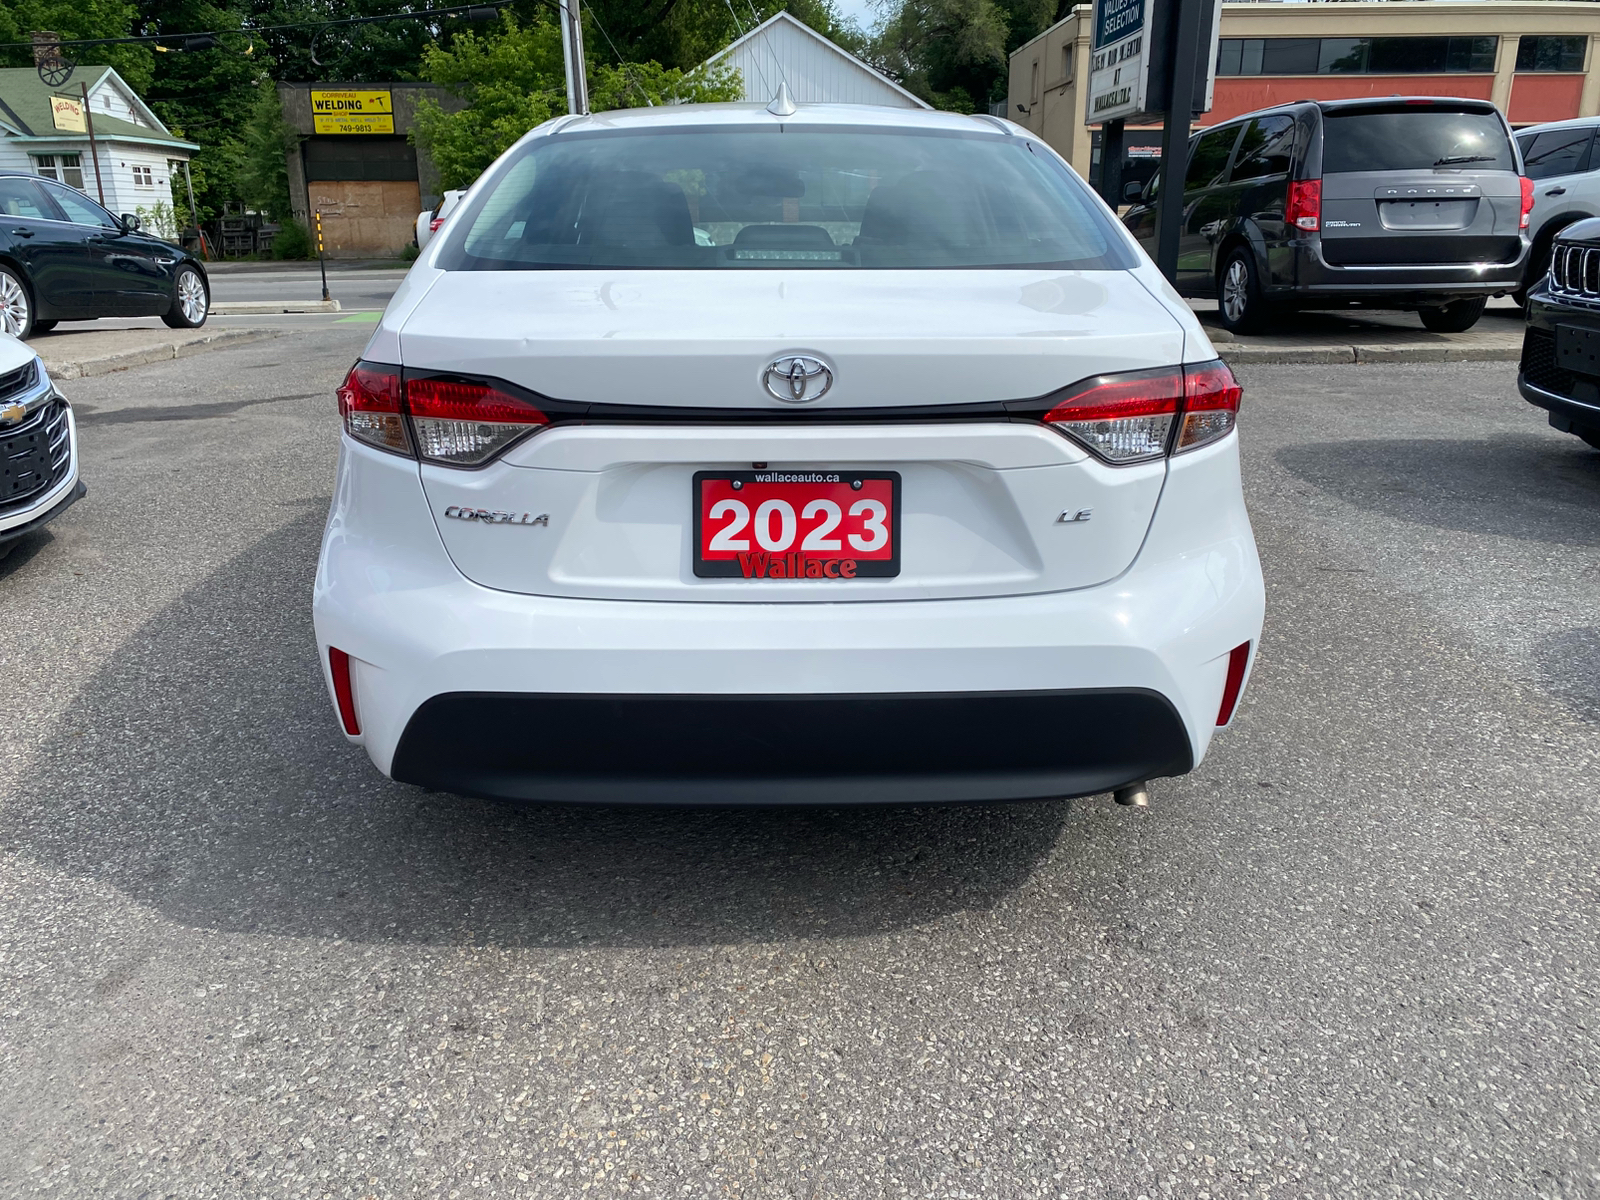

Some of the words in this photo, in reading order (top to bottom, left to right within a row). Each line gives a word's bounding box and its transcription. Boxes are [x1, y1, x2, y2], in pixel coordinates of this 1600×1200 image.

[1104, 4, 1140, 36] SELECTION
[54, 101, 80, 116] WELDING
[314, 100, 363, 110] WELDING
[755, 472, 840, 483] wallaceauto.ca
[444, 505, 550, 527] COROLLA
[1055, 506, 1095, 523] LE
[708, 498, 889, 552] 2023
[736, 551, 858, 579] Wallace
